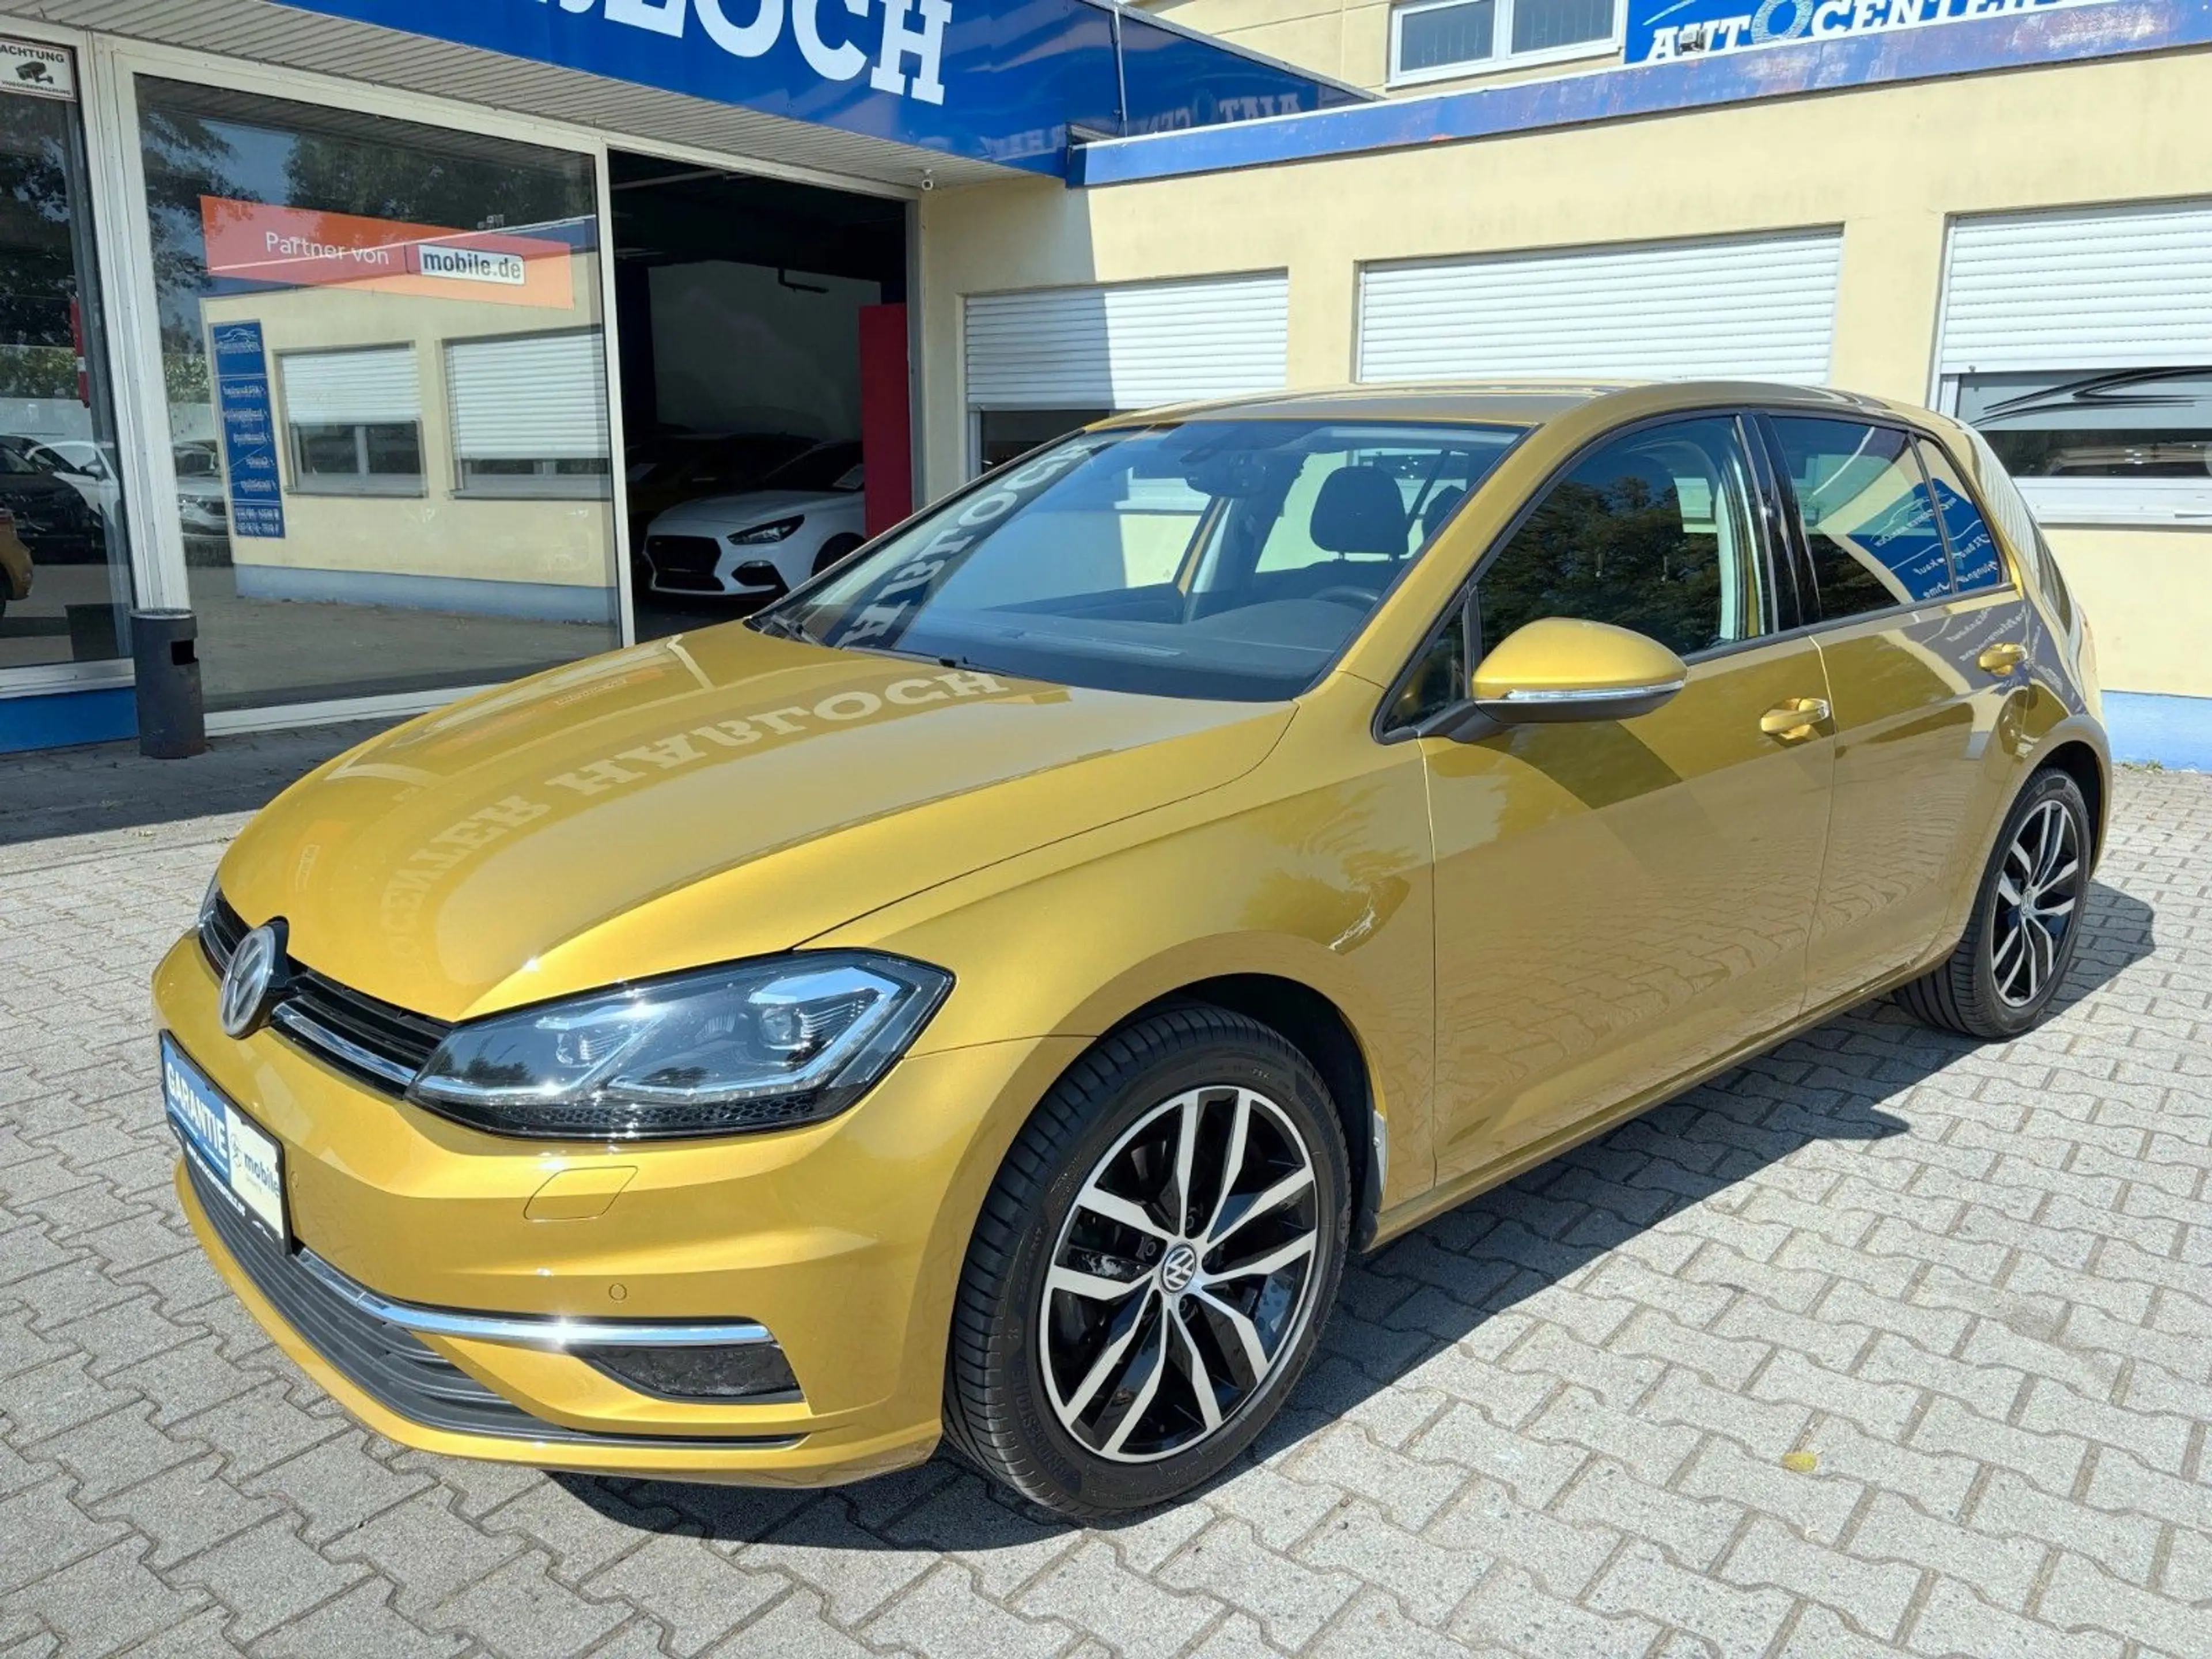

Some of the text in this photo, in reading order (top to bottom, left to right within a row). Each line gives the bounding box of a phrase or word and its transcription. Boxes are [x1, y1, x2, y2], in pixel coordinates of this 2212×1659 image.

[1, 44, 65, 63] ACHTUNG
[535, 0, 952, 105] OCH
[1645, 0, 2042, 61] AUTOCEN
[266, 232, 521, 279] Partner von mobile.de
[166, 1061, 228, 1160] GARANTIE
